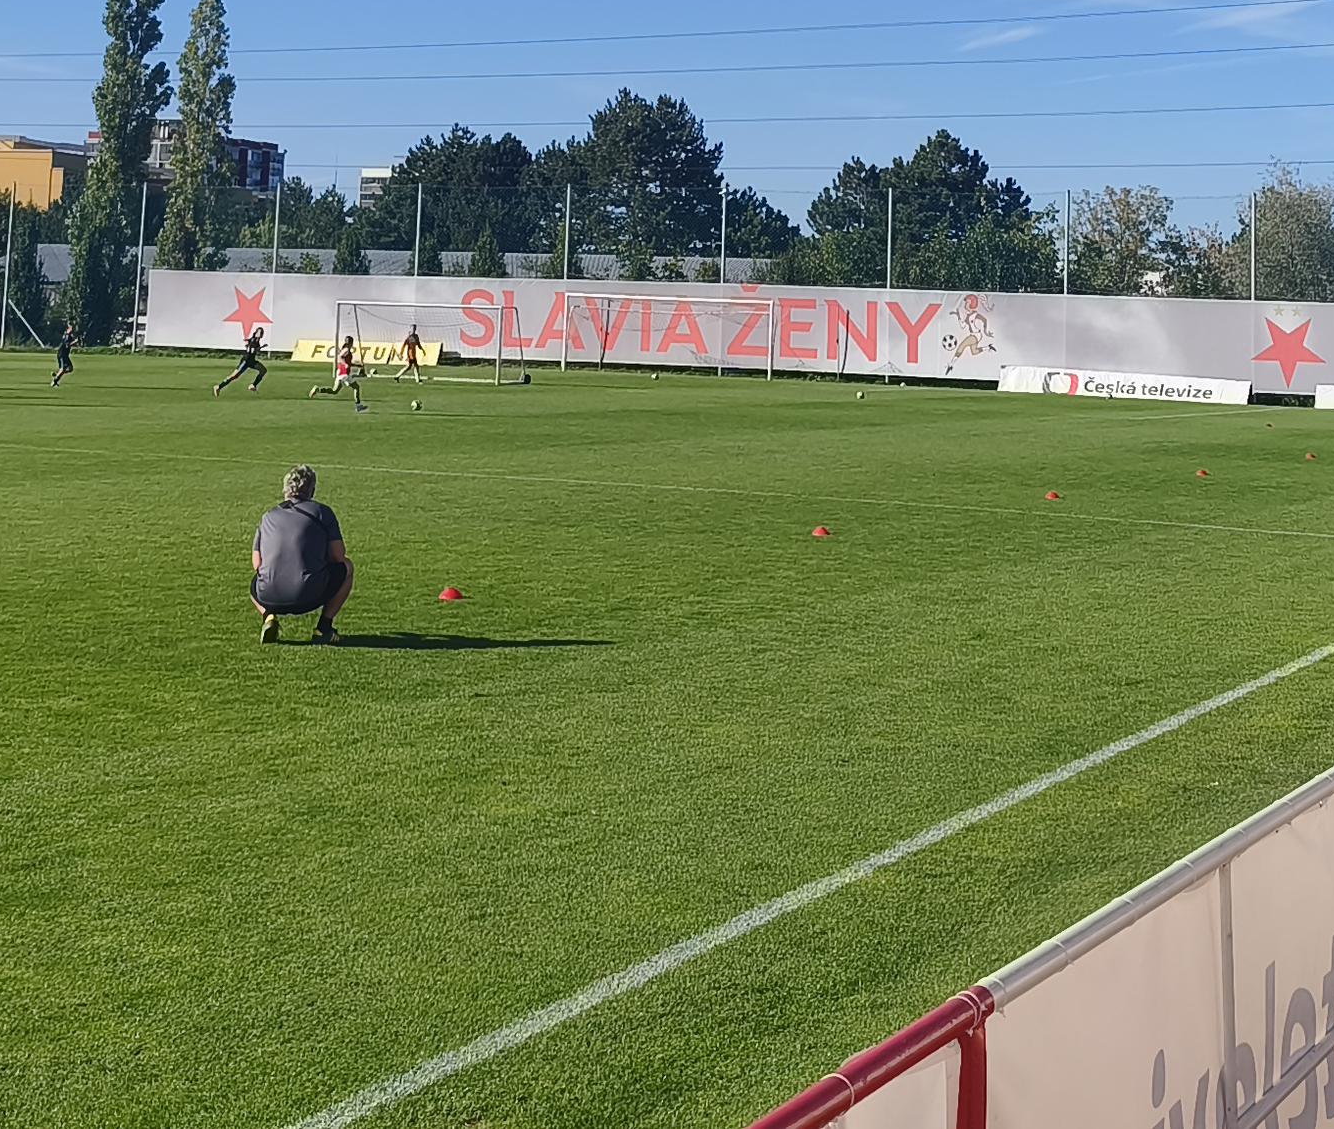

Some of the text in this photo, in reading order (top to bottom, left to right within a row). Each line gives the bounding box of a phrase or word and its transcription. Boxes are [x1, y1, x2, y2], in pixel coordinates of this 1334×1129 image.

[459, 284, 943, 365] SLAVIA ŽENY
[1083, 377, 1213, 399] Česká televize
